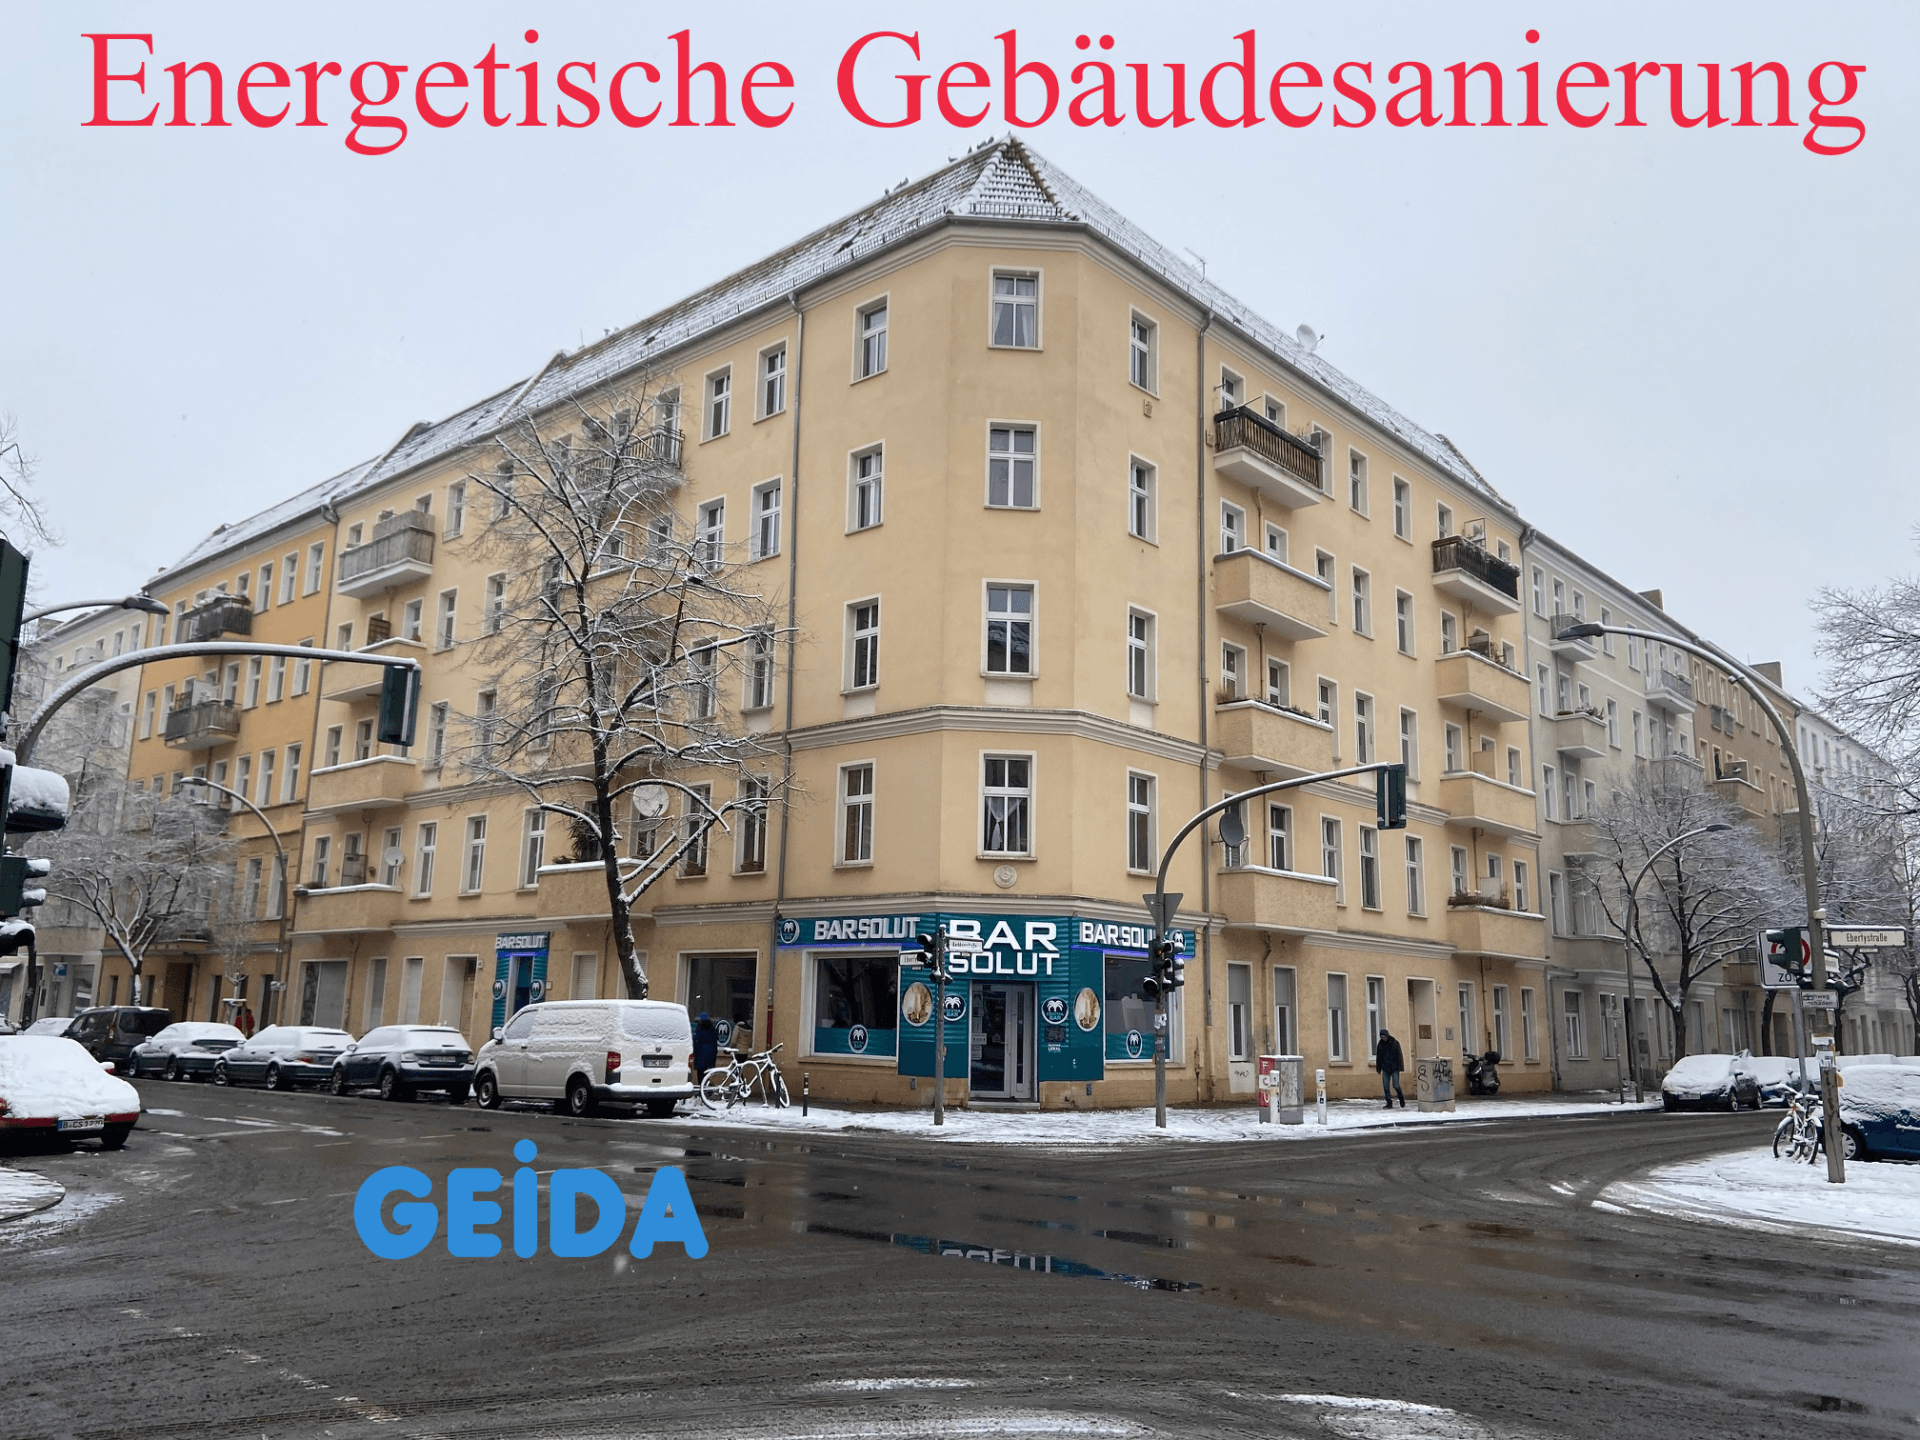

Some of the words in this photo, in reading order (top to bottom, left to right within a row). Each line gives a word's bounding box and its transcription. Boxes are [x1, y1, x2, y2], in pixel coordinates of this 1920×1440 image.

[814, 917, 921, 941] BARSOLUT
[949, 919, 1059, 951] BAR
[1080, 921, 1157, 949] BARSOL
[1846, 933, 1888, 944] Ebertystraße
[495, 935, 547, 949] BARSOLUT
[948, 950, 1060, 976] SOLUT
